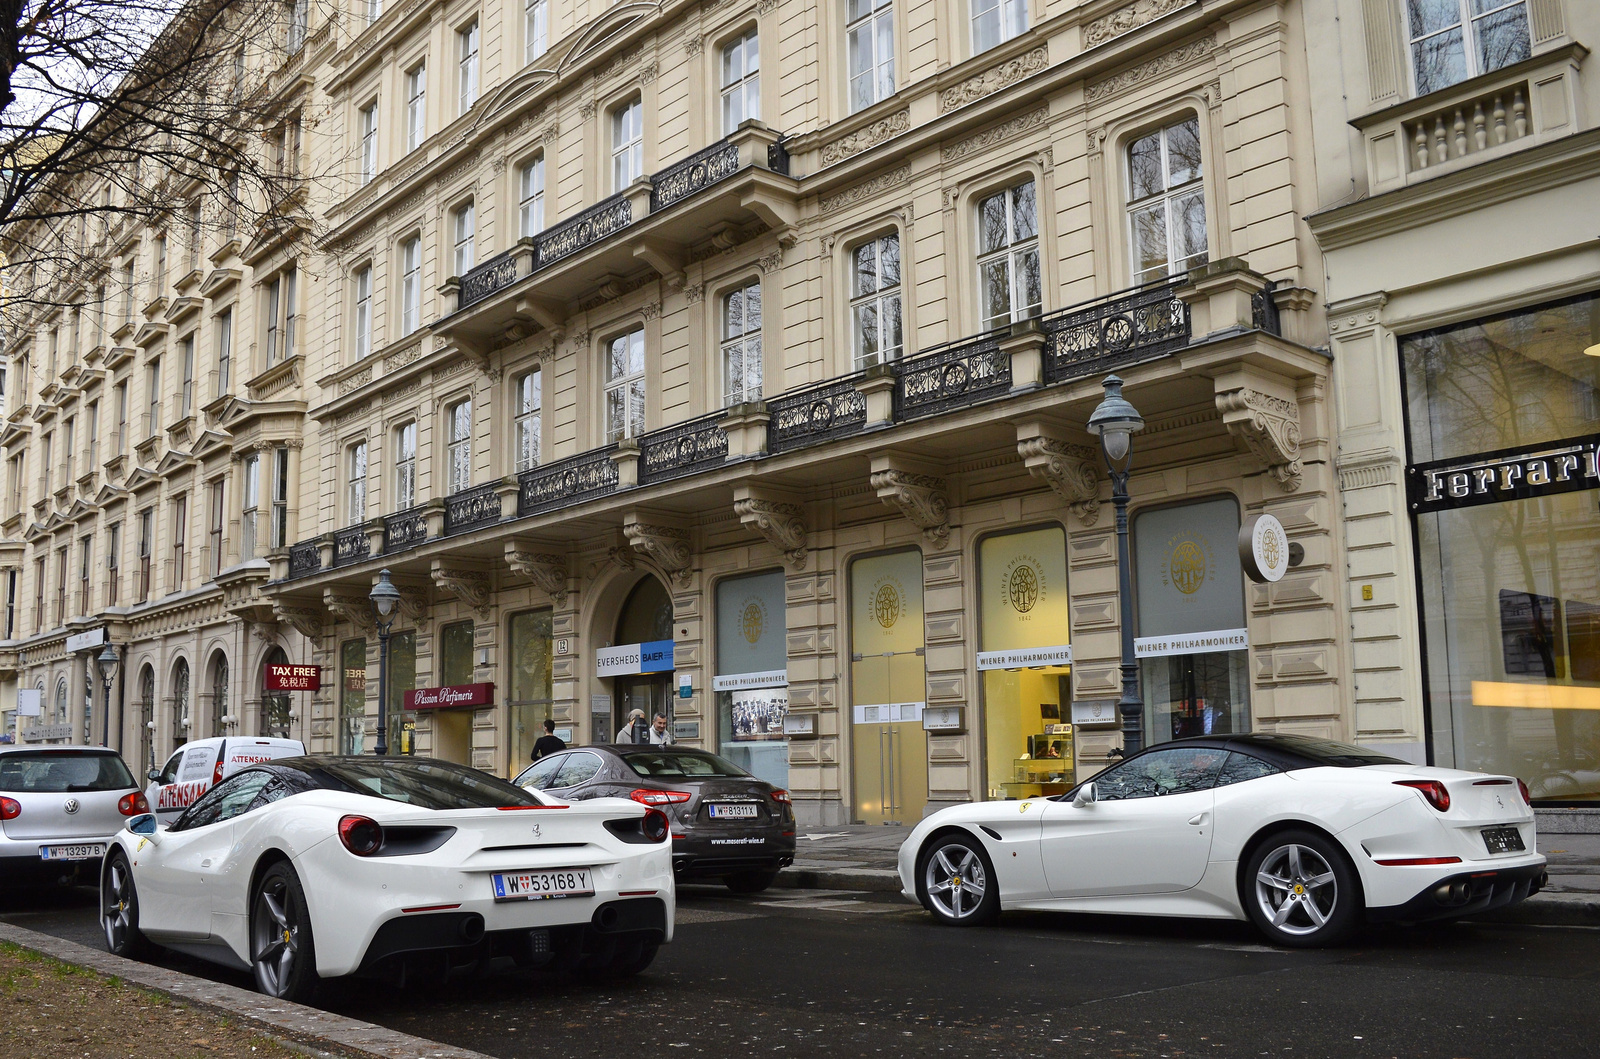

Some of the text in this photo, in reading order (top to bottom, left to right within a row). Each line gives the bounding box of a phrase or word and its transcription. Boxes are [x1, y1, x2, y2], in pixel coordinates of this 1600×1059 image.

[1423, 443, 1598, 502] Ferrari
[1161, 549, 1169, 587] WIENER
[1007, 553, 1047, 602] PHILHARMONIKER
[1137, 635, 1245, 653] WIENER PHILHARMONIKER
[597, 654, 640, 668] EVERSHEDS
[642, 651, 664, 663] BAIER
[980, 651, 1069, 666] WIENER PHILHARMONIKER
[272, 666, 317, 677] TAX FREE
[279, 676, 309, 688] 免税店
[718, 674, 786, 688] WIENER PHILHARMONIKER
[414, 687, 473, 705] Passion Parfümerie
[231, 755, 272, 763] ATTENSAM
[158, 782, 207, 808] ATTENSAM
[717, 806, 754, 816] W 81311 X
[711, 837, 765, 845] www.maserati-wien.at
[50, 845, 100, 857] W 13297 B
[507, 872, 586, 893] W 53168 Y
